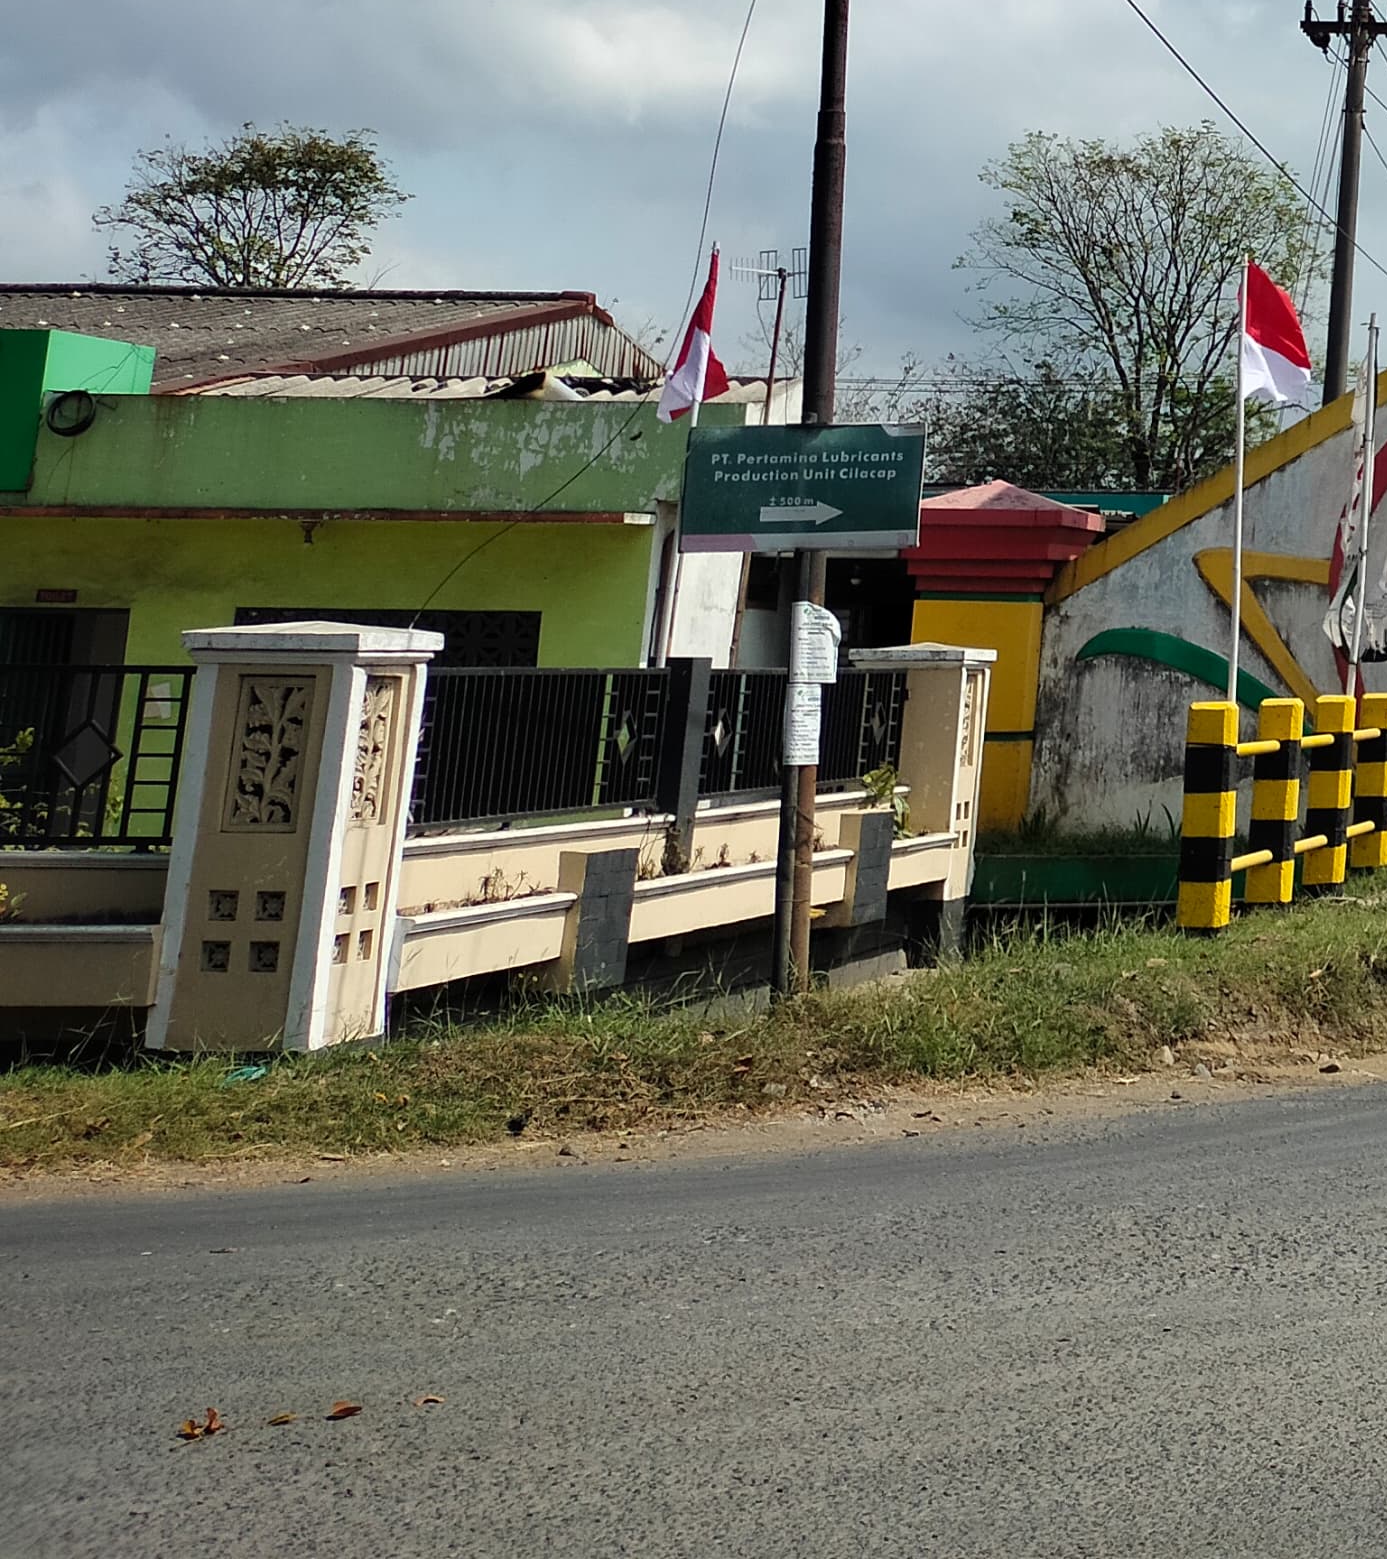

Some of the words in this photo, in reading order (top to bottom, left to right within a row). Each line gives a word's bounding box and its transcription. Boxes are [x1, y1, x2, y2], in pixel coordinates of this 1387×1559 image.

[711, 453, 733, 465] PT.
[737, 452, 818, 465] Pertamina
[822, 450, 904, 463] Lubricants
[714, 469, 799, 482] Production
[803, 468, 835, 481] Unit
[839, 467, 897, 481] Cilacap
[780, 496, 801, 506] 500
